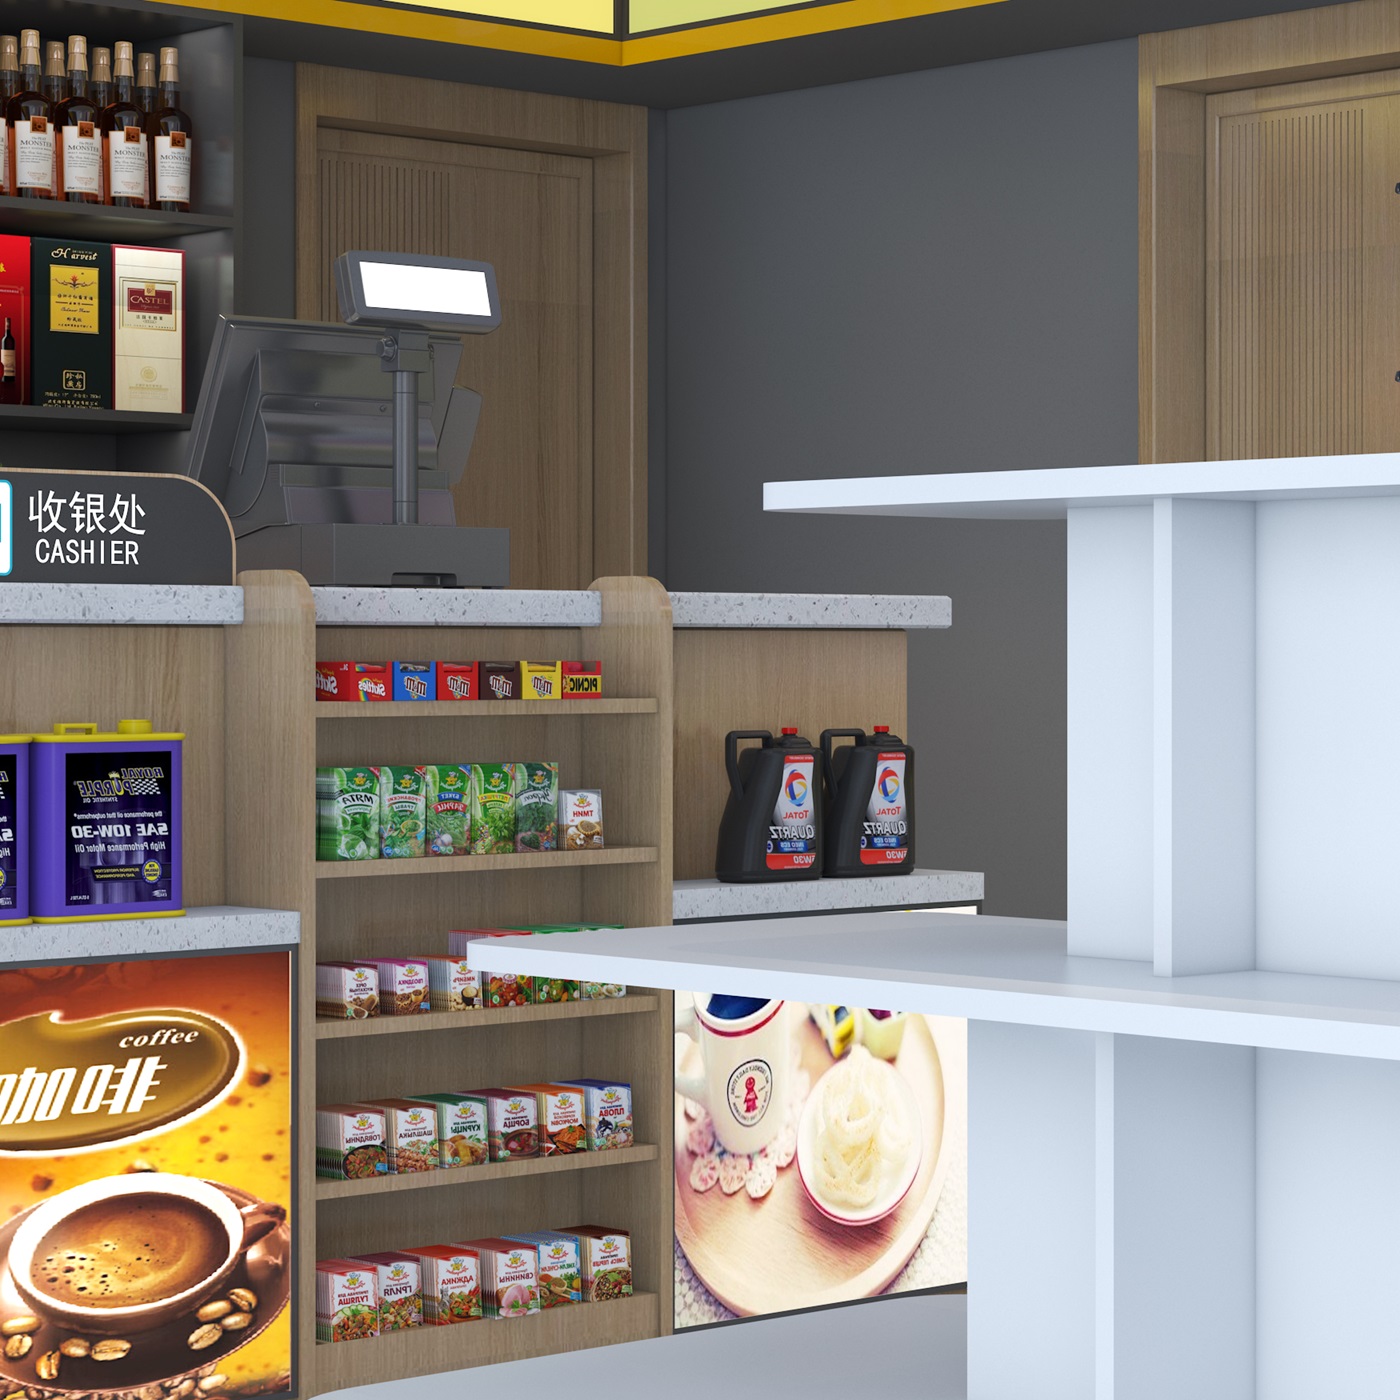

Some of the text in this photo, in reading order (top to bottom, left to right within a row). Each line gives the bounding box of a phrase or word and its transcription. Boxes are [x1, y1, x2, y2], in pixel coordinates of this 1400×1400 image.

[51, 248, 98, 261] Harvest
[130, 295, 169, 305] CASTEL
[29, 490, 146, 535] 收银处
[36, 539, 139, 565] CASHIER
[119, 1028, 198, 1048] coffee
[0, 1056, 168, 1125] 咖啡
